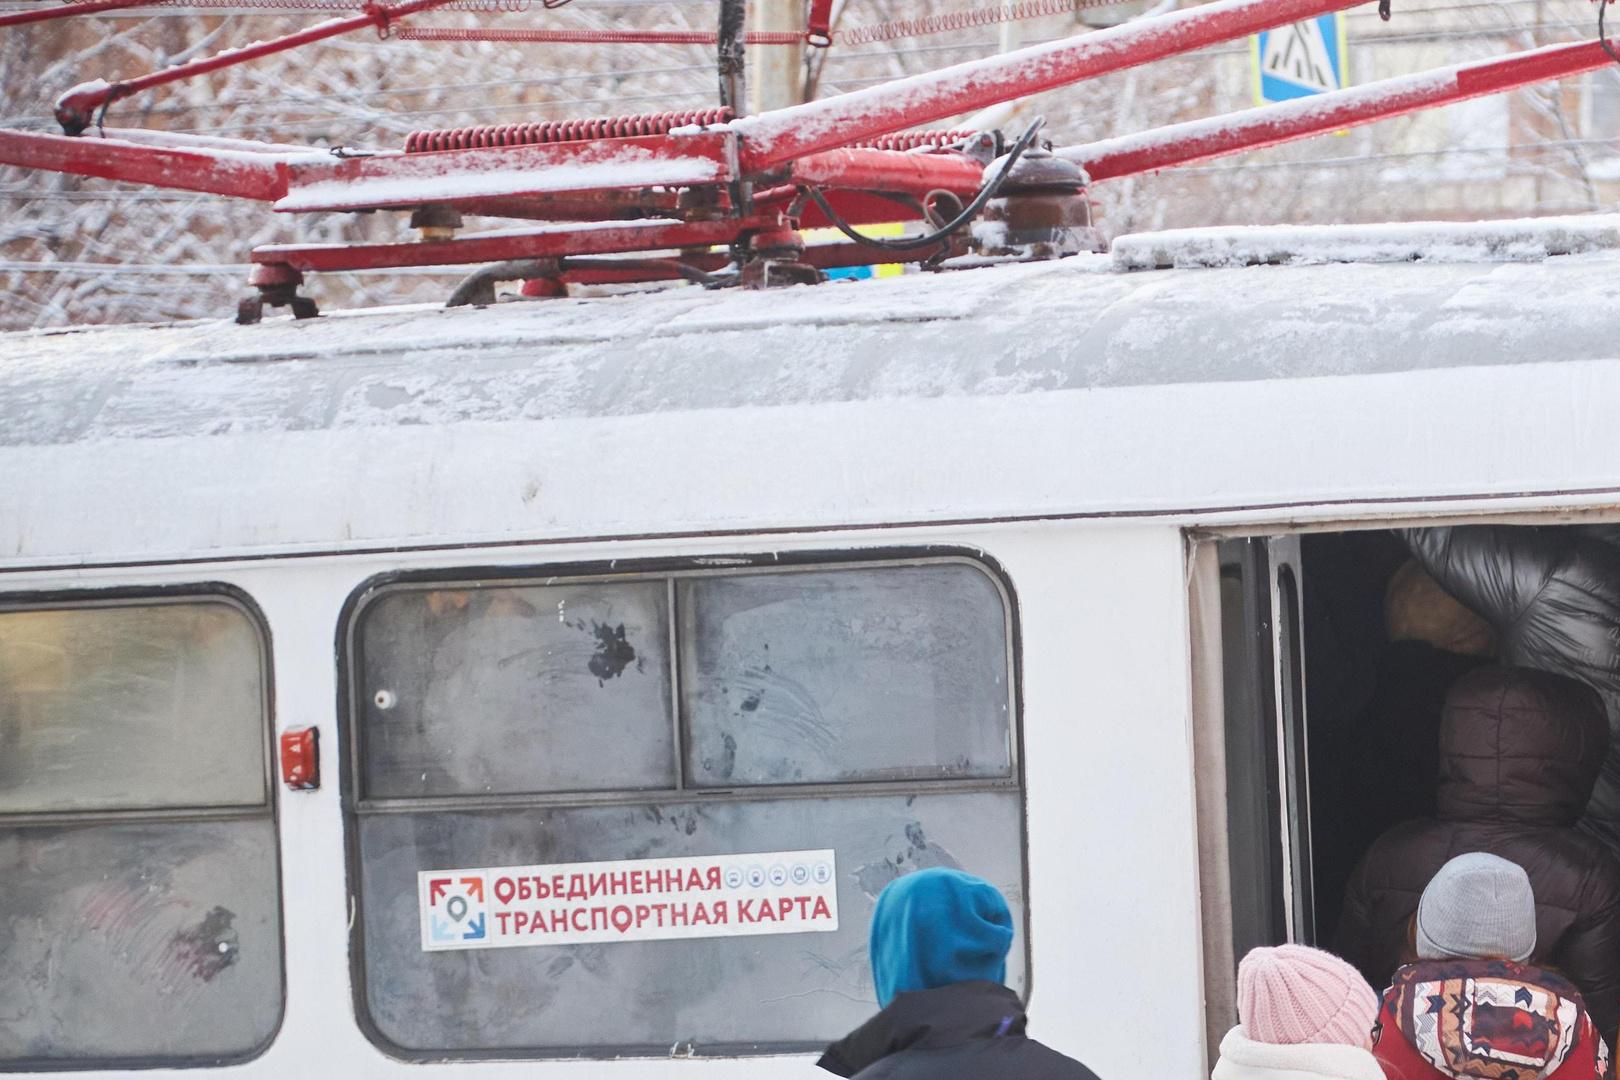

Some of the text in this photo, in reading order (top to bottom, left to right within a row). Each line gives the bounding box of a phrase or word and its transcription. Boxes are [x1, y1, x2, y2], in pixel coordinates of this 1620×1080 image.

[494, 866, 722, 905] ОБЪЕДИНЕННАЯ
[495, 896, 832, 933] ТРАНСПОРТНАЯ КАРТА
